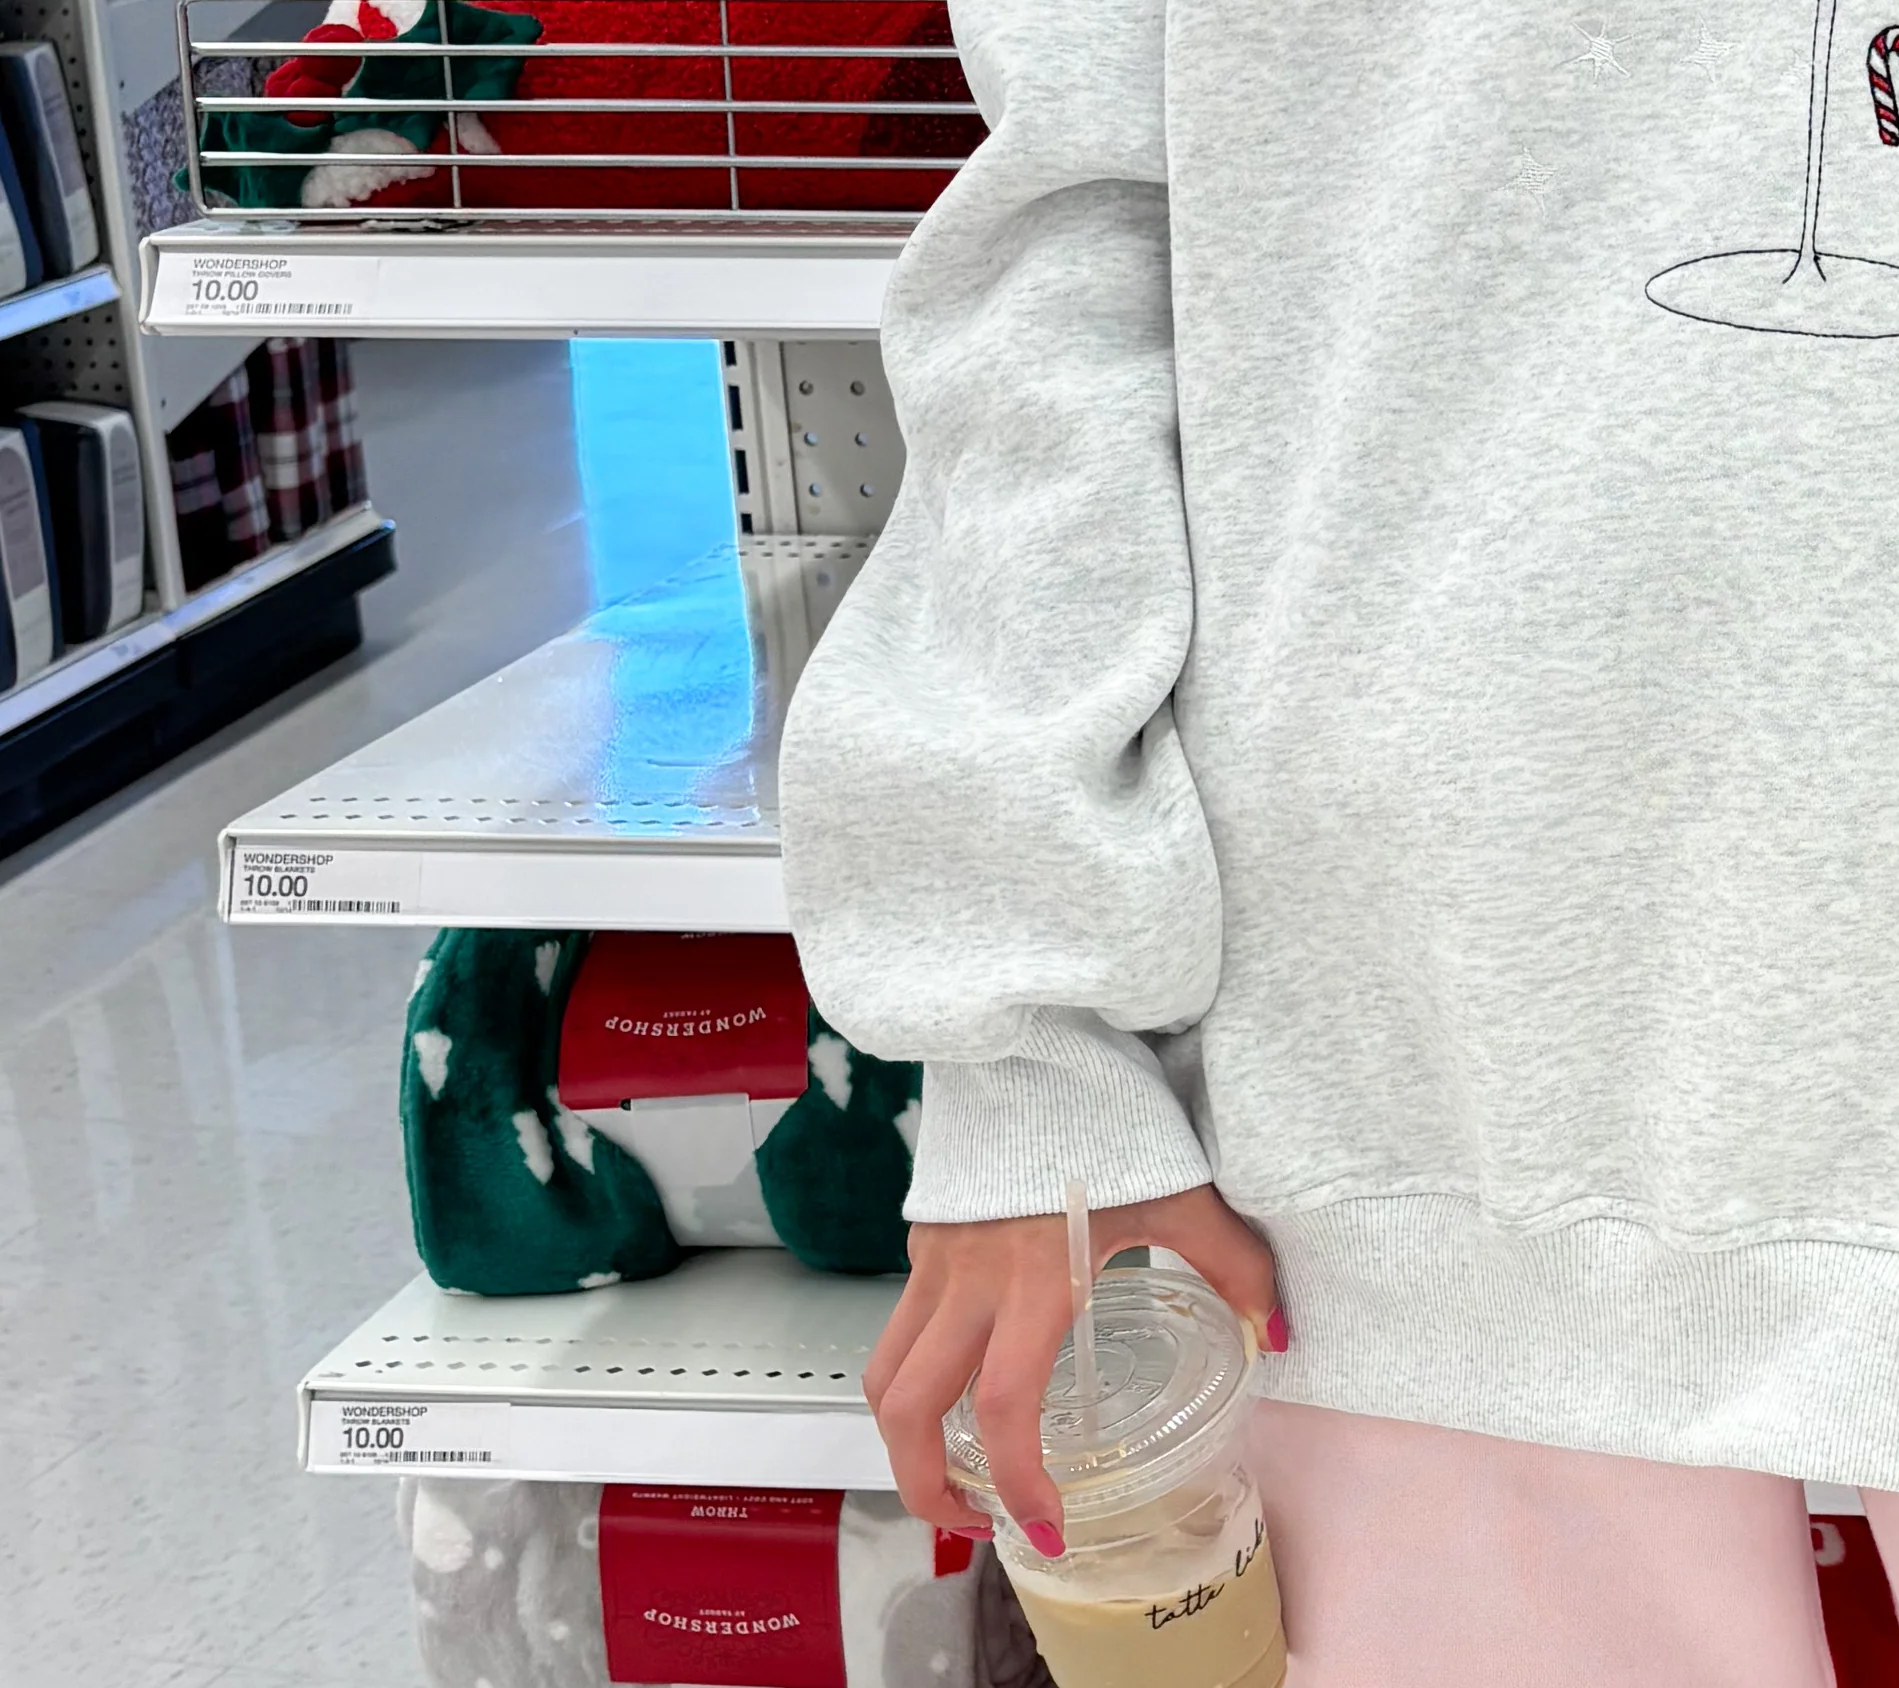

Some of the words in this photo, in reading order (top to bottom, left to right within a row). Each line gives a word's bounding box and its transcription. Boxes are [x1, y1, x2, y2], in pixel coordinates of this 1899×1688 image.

[193, 258, 288, 270] WONDERSHOP
[192, 279, 259, 302] 10.00
[243, 853, 334, 866] WONDERSHOP
[244, 874, 308, 897] 10.00
[605, 1006, 767, 1037] WONDERSHOP
[342, 1406, 428, 1418] WONDERSHOP
[342, 1427, 404, 1449] 10.00
[690, 1505, 748, 1518] THROW
[643, 1608, 800, 1635] WONDERSHOP
